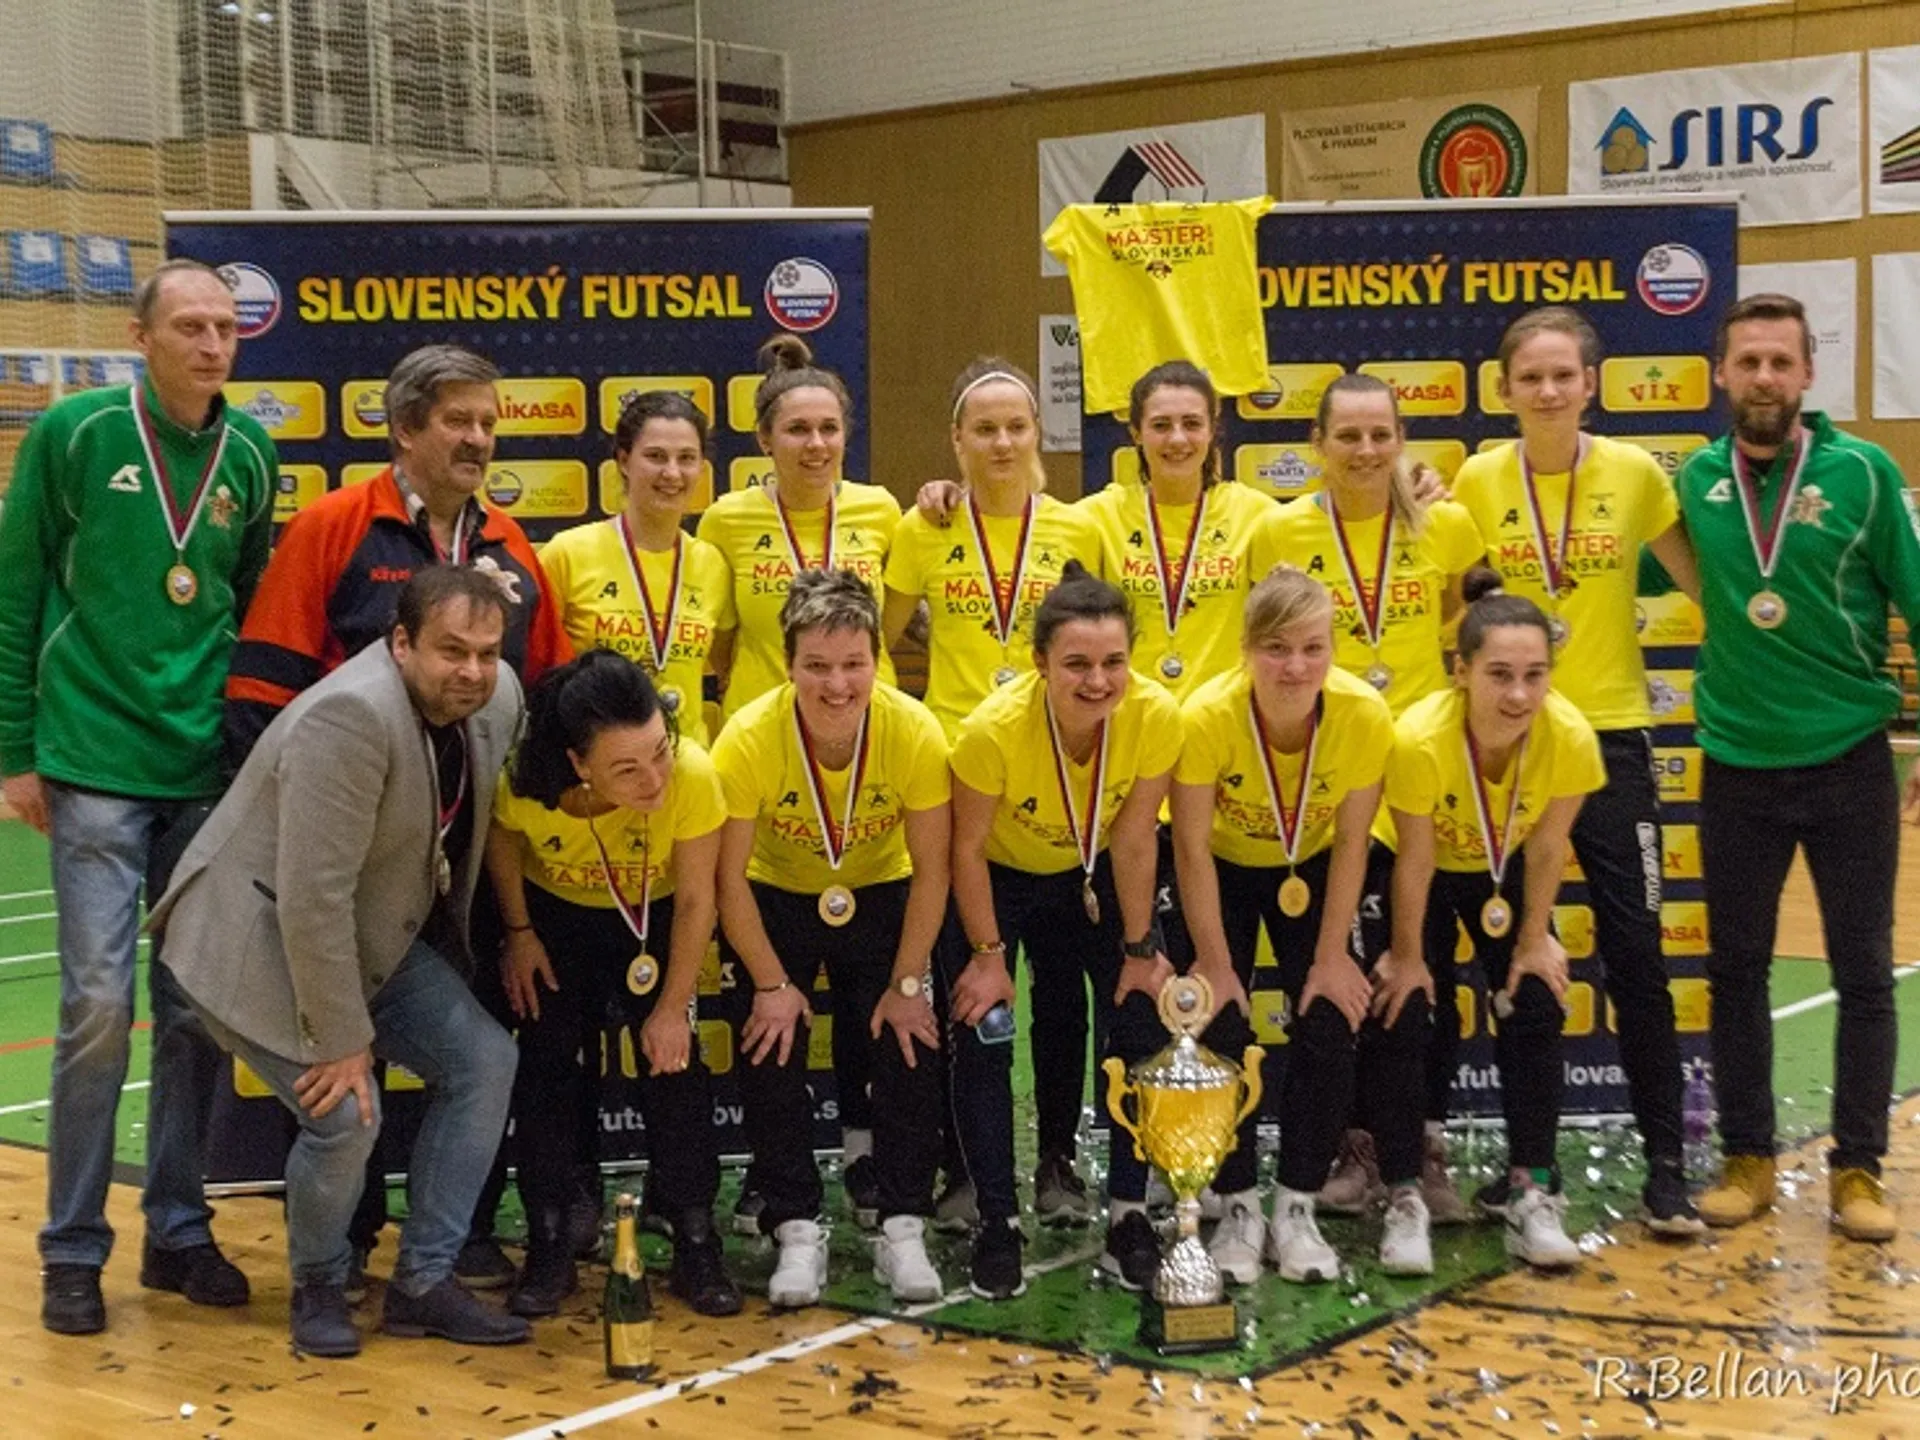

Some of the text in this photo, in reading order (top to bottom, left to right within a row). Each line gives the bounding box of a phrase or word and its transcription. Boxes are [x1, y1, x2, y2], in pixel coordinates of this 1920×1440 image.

[1657, 96, 1835, 171] SIRS
[299, 264, 752, 322] SLOVENSKÝ FUTSAL
[1260, 253, 1626, 308] OVENSKÝ FUTSAL
